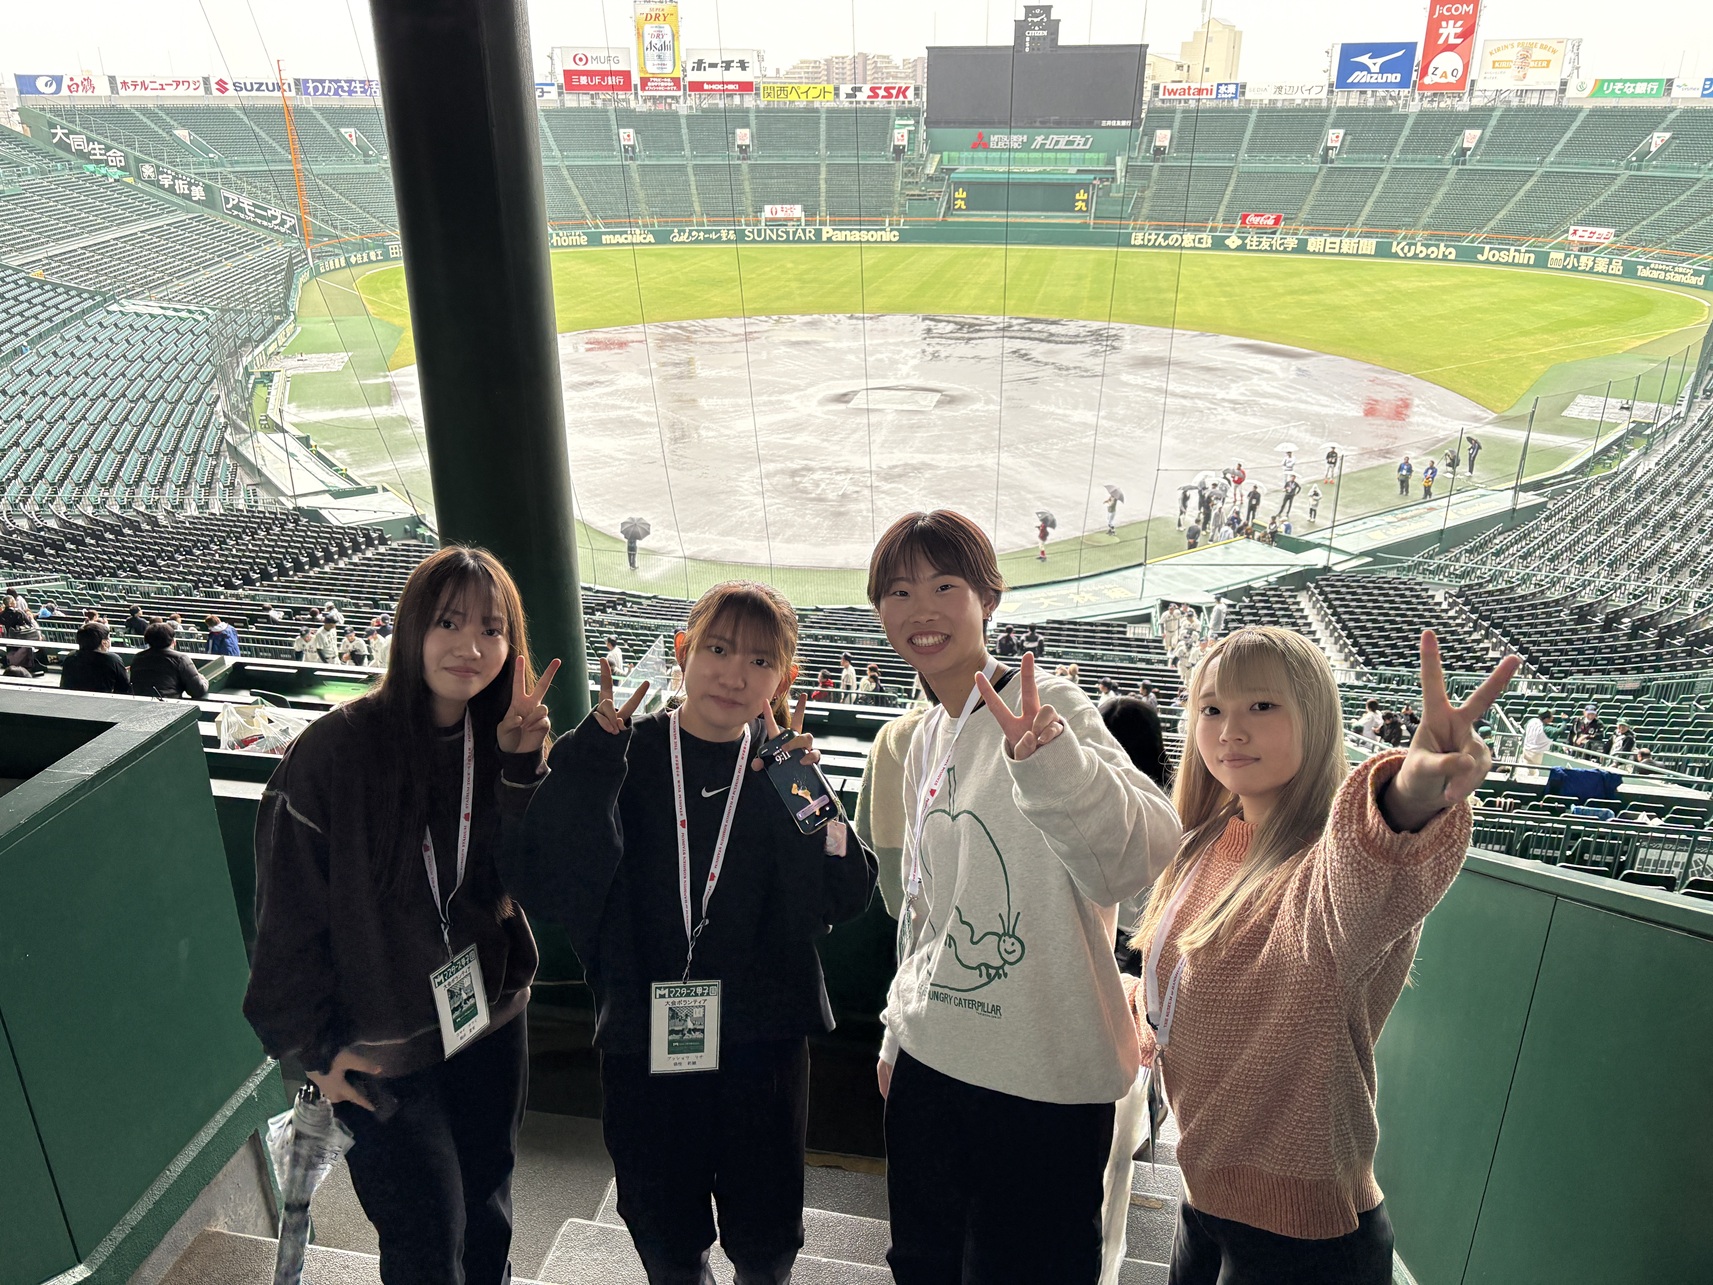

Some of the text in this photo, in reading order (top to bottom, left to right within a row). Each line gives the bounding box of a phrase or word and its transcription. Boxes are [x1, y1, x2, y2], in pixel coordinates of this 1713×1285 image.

[1433, 4, 1474, 18] J:COM
[1437, 20, 1464, 44] 光
[646, 40, 672, 52] Asahi
[1489, 42, 1515, 56] KIRIN'S
[1539, 43, 1559, 55] BREW
[590, 55, 620, 65] MUFG
[691, 58, 750, 72] ホーチキ
[572, 75, 624, 86] 三菱UFJ銀行
[1346, 71, 1402, 83] MIZUNO
[67, 76, 96, 94] 白鶴
[120, 79, 201, 92] ホテルニューアワジ
[233, 81, 292, 93] SUZUKI
[307, 80, 380, 97] わかさ生活
[762, 85, 832, 99] 関西ペイント
[866, 85, 911, 99] SSK
[1162, 85, 1214, 96] Iwatani
[1603, 81, 1658, 95] りそな銀行
[990, 134, 1027, 142] MITSUBISHI
[990, 141, 1022, 149] ELECTRIC
[50, 125, 125, 168] 大同生命
[158, 174, 206, 200] 宇佐美
[222, 192, 295, 228] アモーヴァ
[744, 228, 816, 241] SUNSTAR
[822, 228, 900, 242] Panasonic
[1130, 232, 1207, 248] ほけんの窓口
[1570, 228, 1614, 241] 不二サッシ
[1245, 236, 1298, 251] 住友化学
[1306, 238, 1376, 255] 朝日新聞
[1392, 241, 1456, 260] Kubota
[1477, 246, 1536, 265] Joshin
[1564, 254, 1624, 275] 小野薬品
[1636, 265, 1665, 280] Takara
[1665, 271, 1706, 286] standard
[954, 997, 1002, 1016] CATERPILLAR
